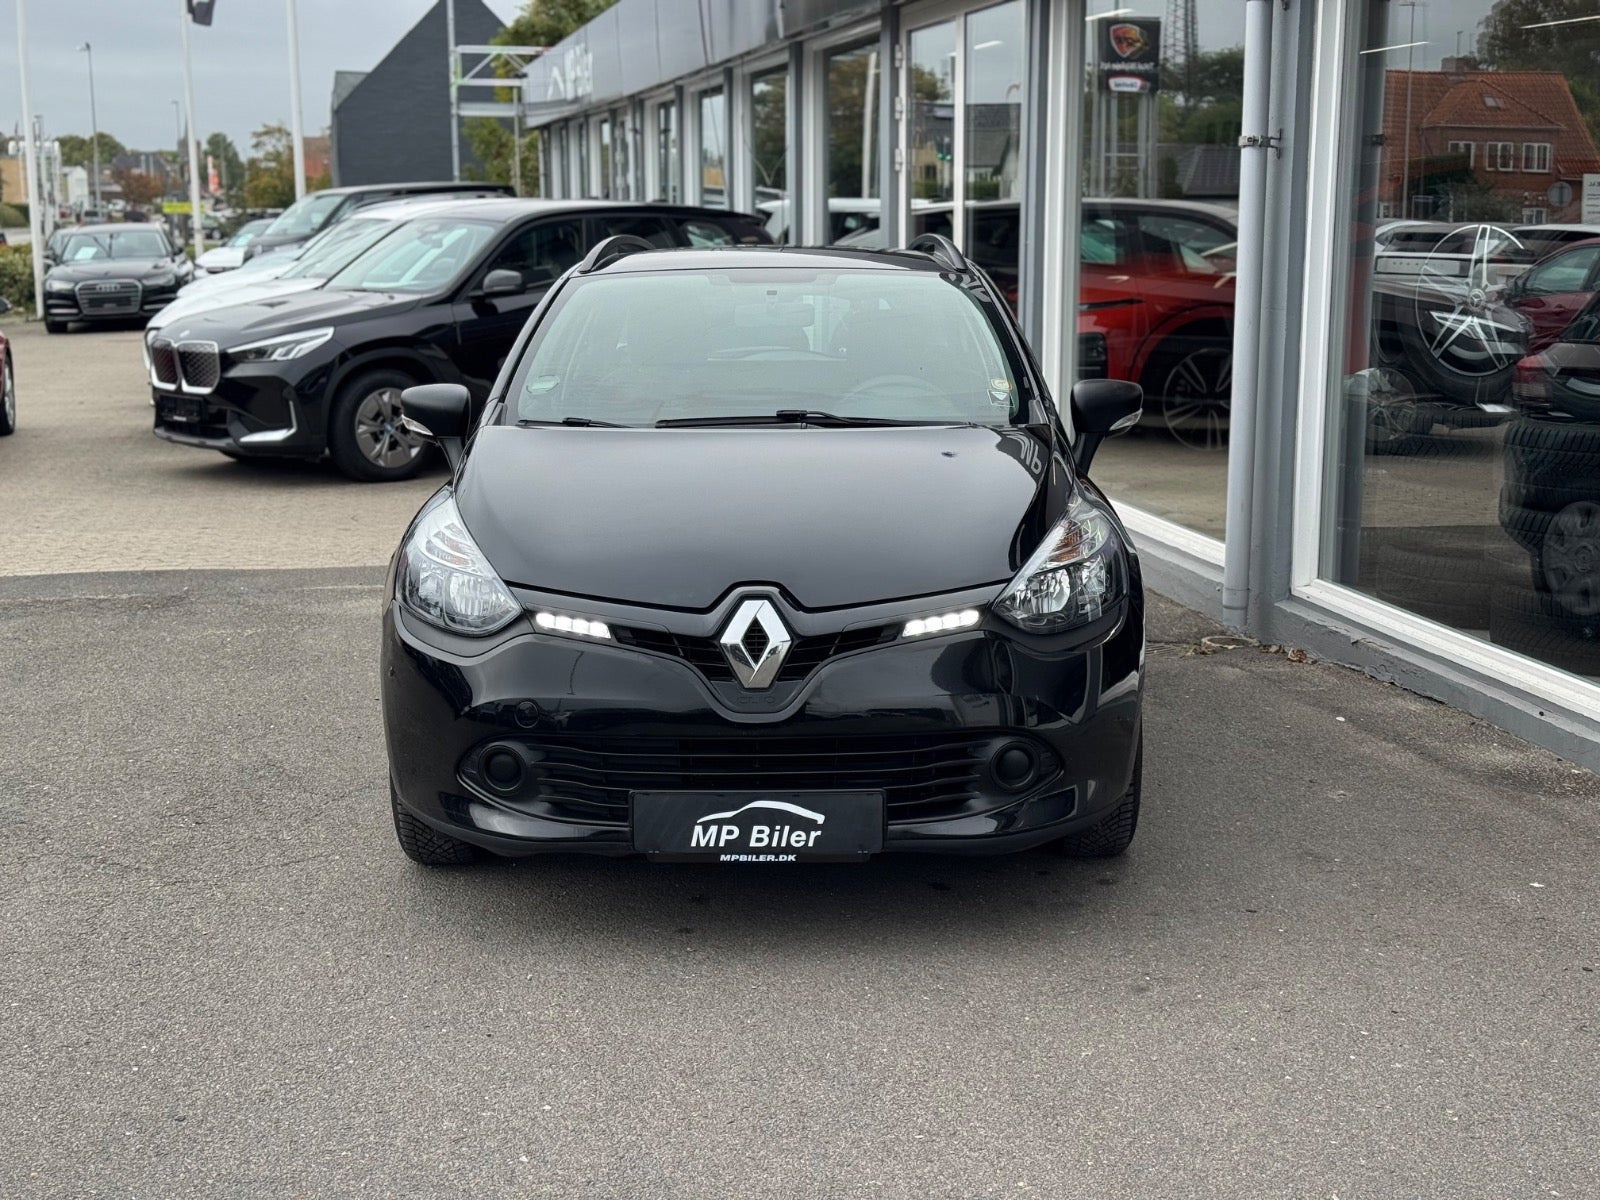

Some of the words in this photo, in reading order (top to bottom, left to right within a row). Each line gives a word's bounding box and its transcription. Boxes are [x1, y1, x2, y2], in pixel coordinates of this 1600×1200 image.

[690, 825, 740, 848] MP
[749, 825, 822, 848] Biler
[719, 854, 797, 862] MPBILER.DK
